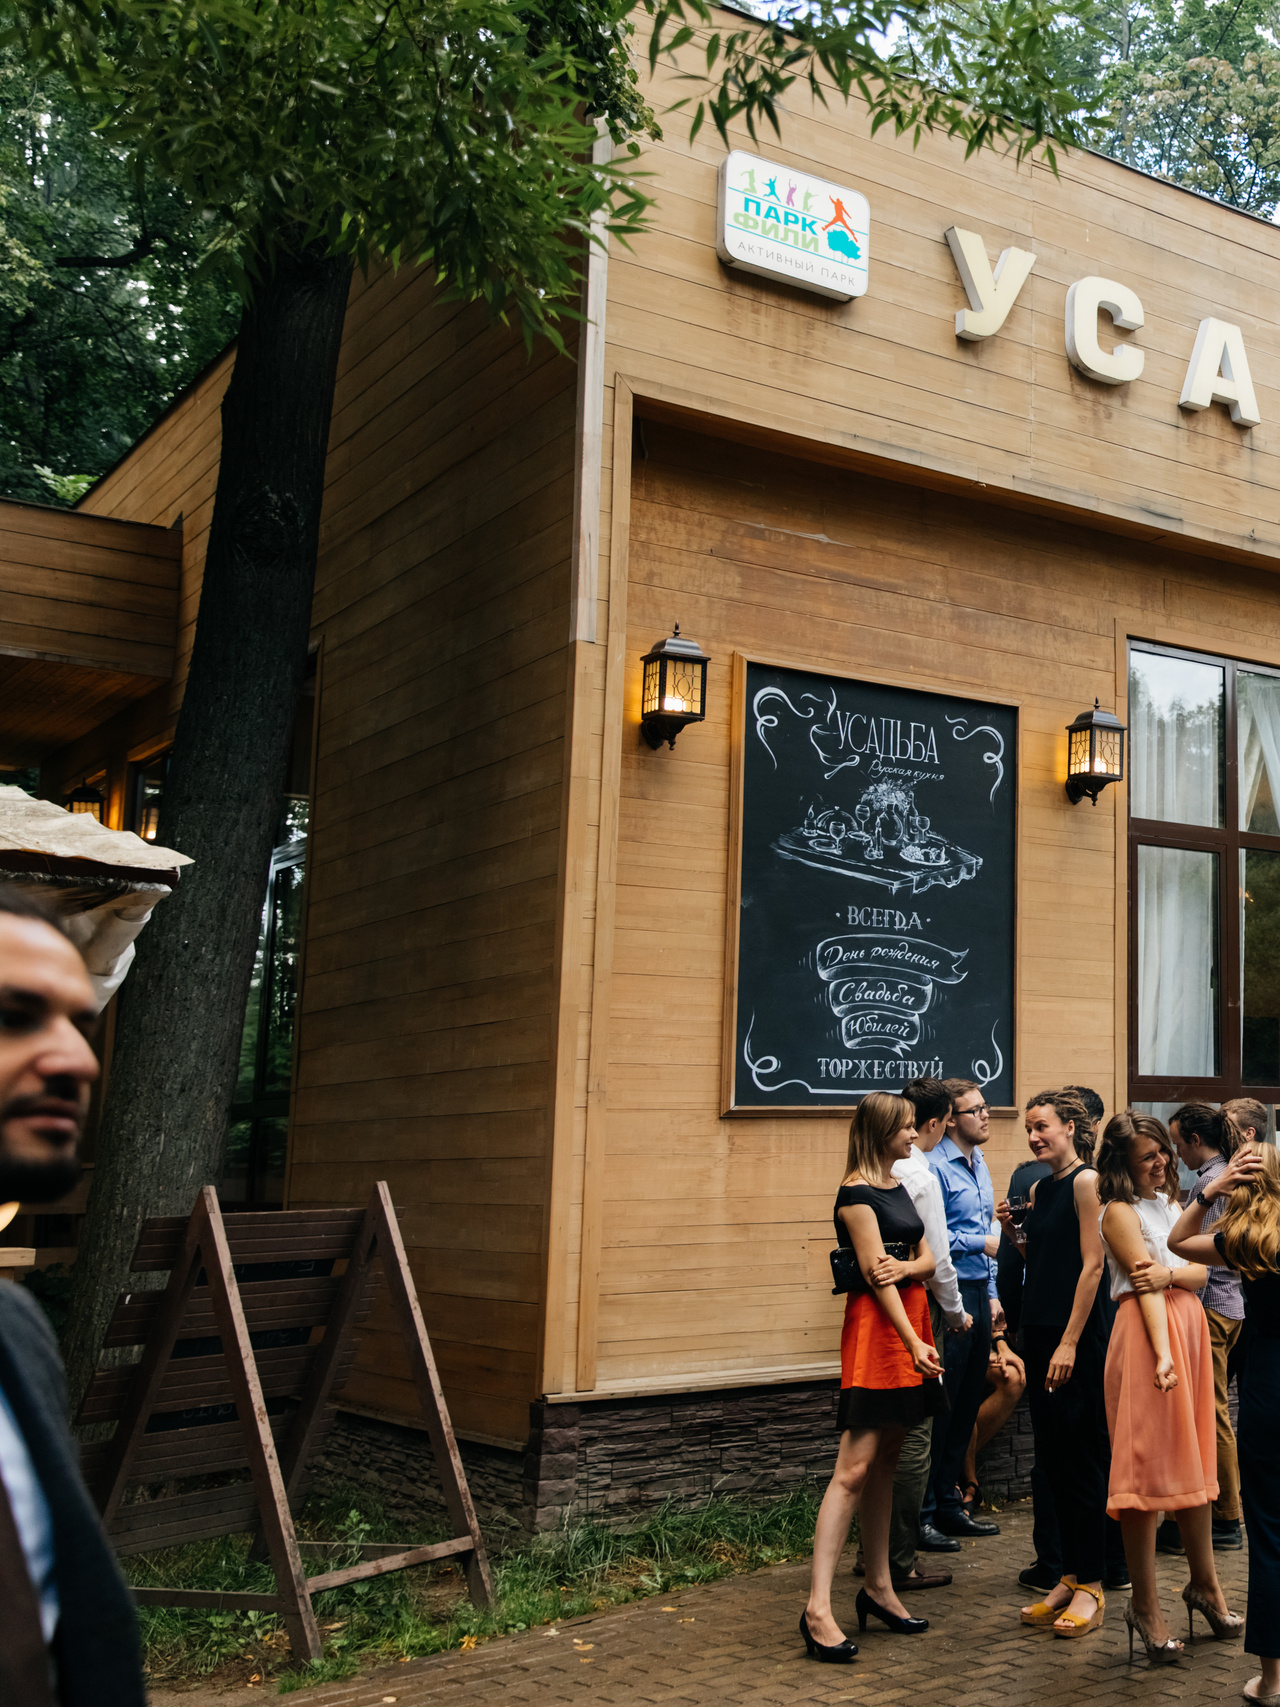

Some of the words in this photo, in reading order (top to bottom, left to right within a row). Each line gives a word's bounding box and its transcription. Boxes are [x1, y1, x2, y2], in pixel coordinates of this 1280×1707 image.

[744, 197, 818, 236] ПАРК
[733, 212, 819, 253] ФИЛИ
[737, 241, 814, 273] АКТИВНЫЙ
[821, 267, 855, 287] ПАРК
[836, 711, 940, 764] УСАДЬБА
[868, 759, 912, 778] Русская
[913, 769, 945, 781] кухня
[847, 906, 923, 931] ВСЕГДА
[824, 946, 865, 967] День
[870, 942, 940, 969] рождения
[839, 982, 916, 1006] Свадьба
[847, 1015, 910, 1037] Юбилей
[817, 1056, 944, 1080] ТОРЖЕСТВУЙ
